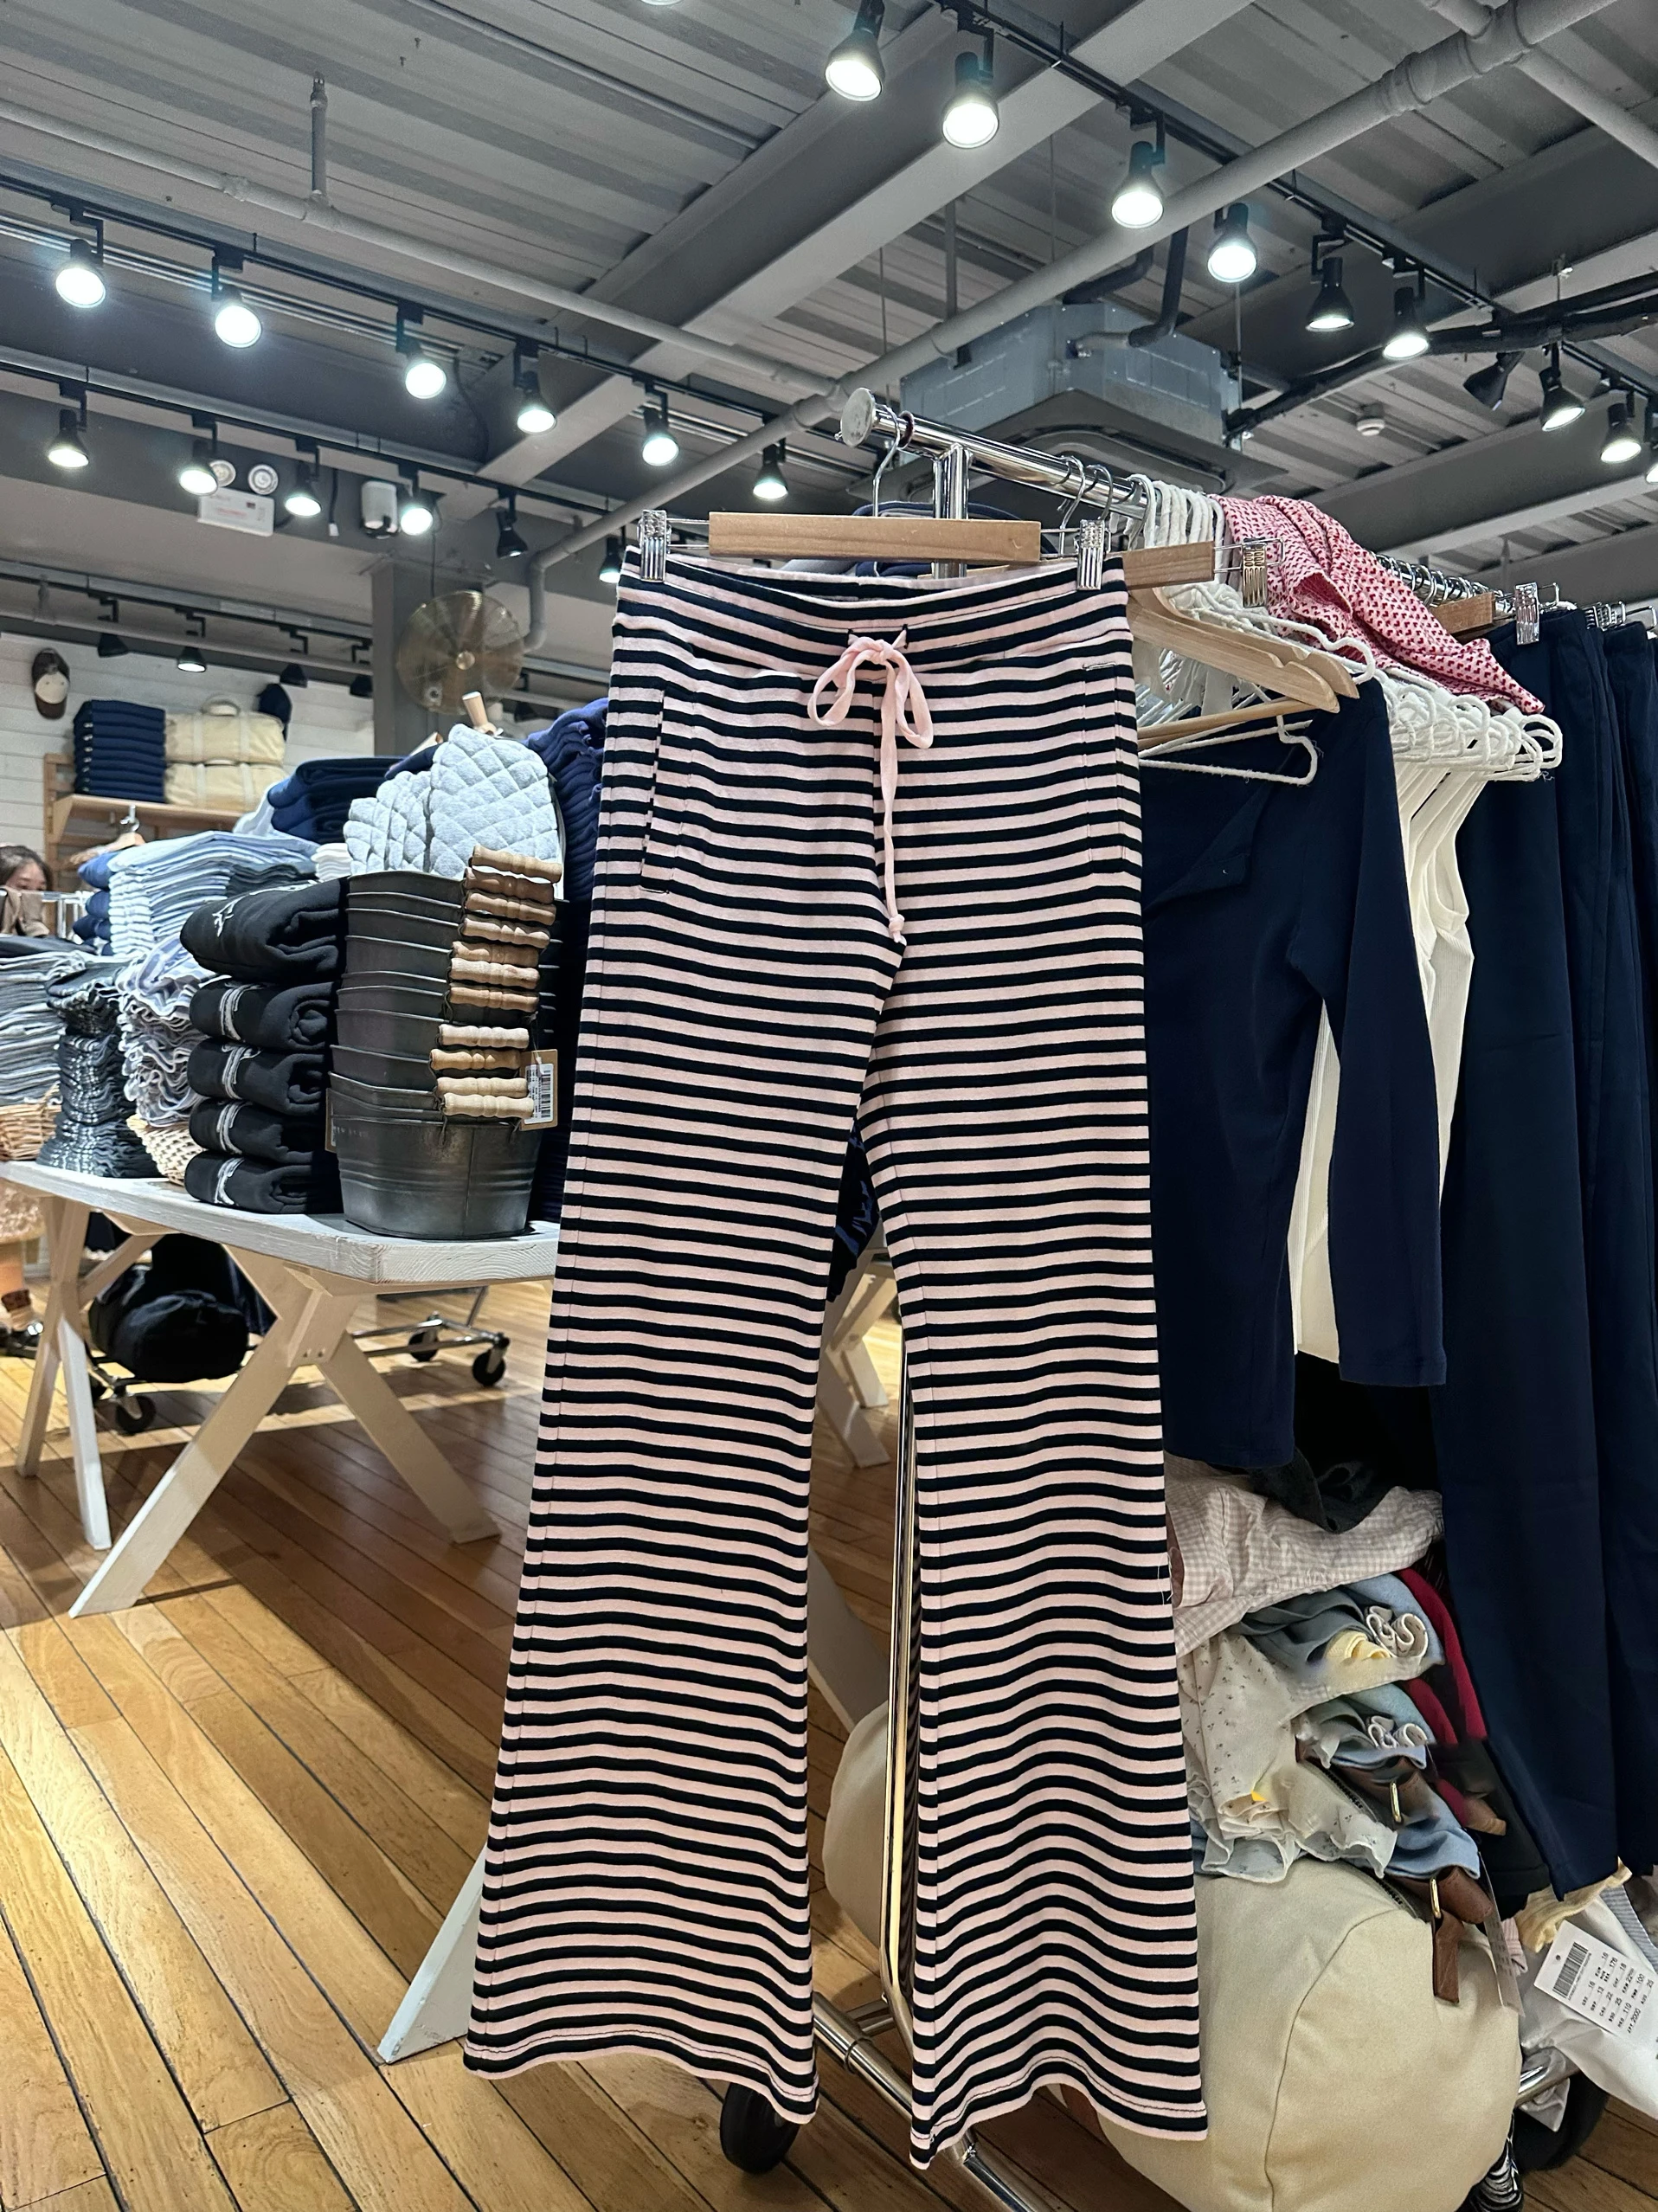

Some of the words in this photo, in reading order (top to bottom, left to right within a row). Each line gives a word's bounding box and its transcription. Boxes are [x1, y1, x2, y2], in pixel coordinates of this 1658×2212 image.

[1635, 1972, 1645, 1984] 100
[1646, 1978, 1654, 1989] 25
[1605, 1990, 1613, 2002] 22
[1614, 1997, 1622, 2006] 25
[1623, 2003, 1631, 2015] 110
[1630, 2008, 1641, 2023] 2000
